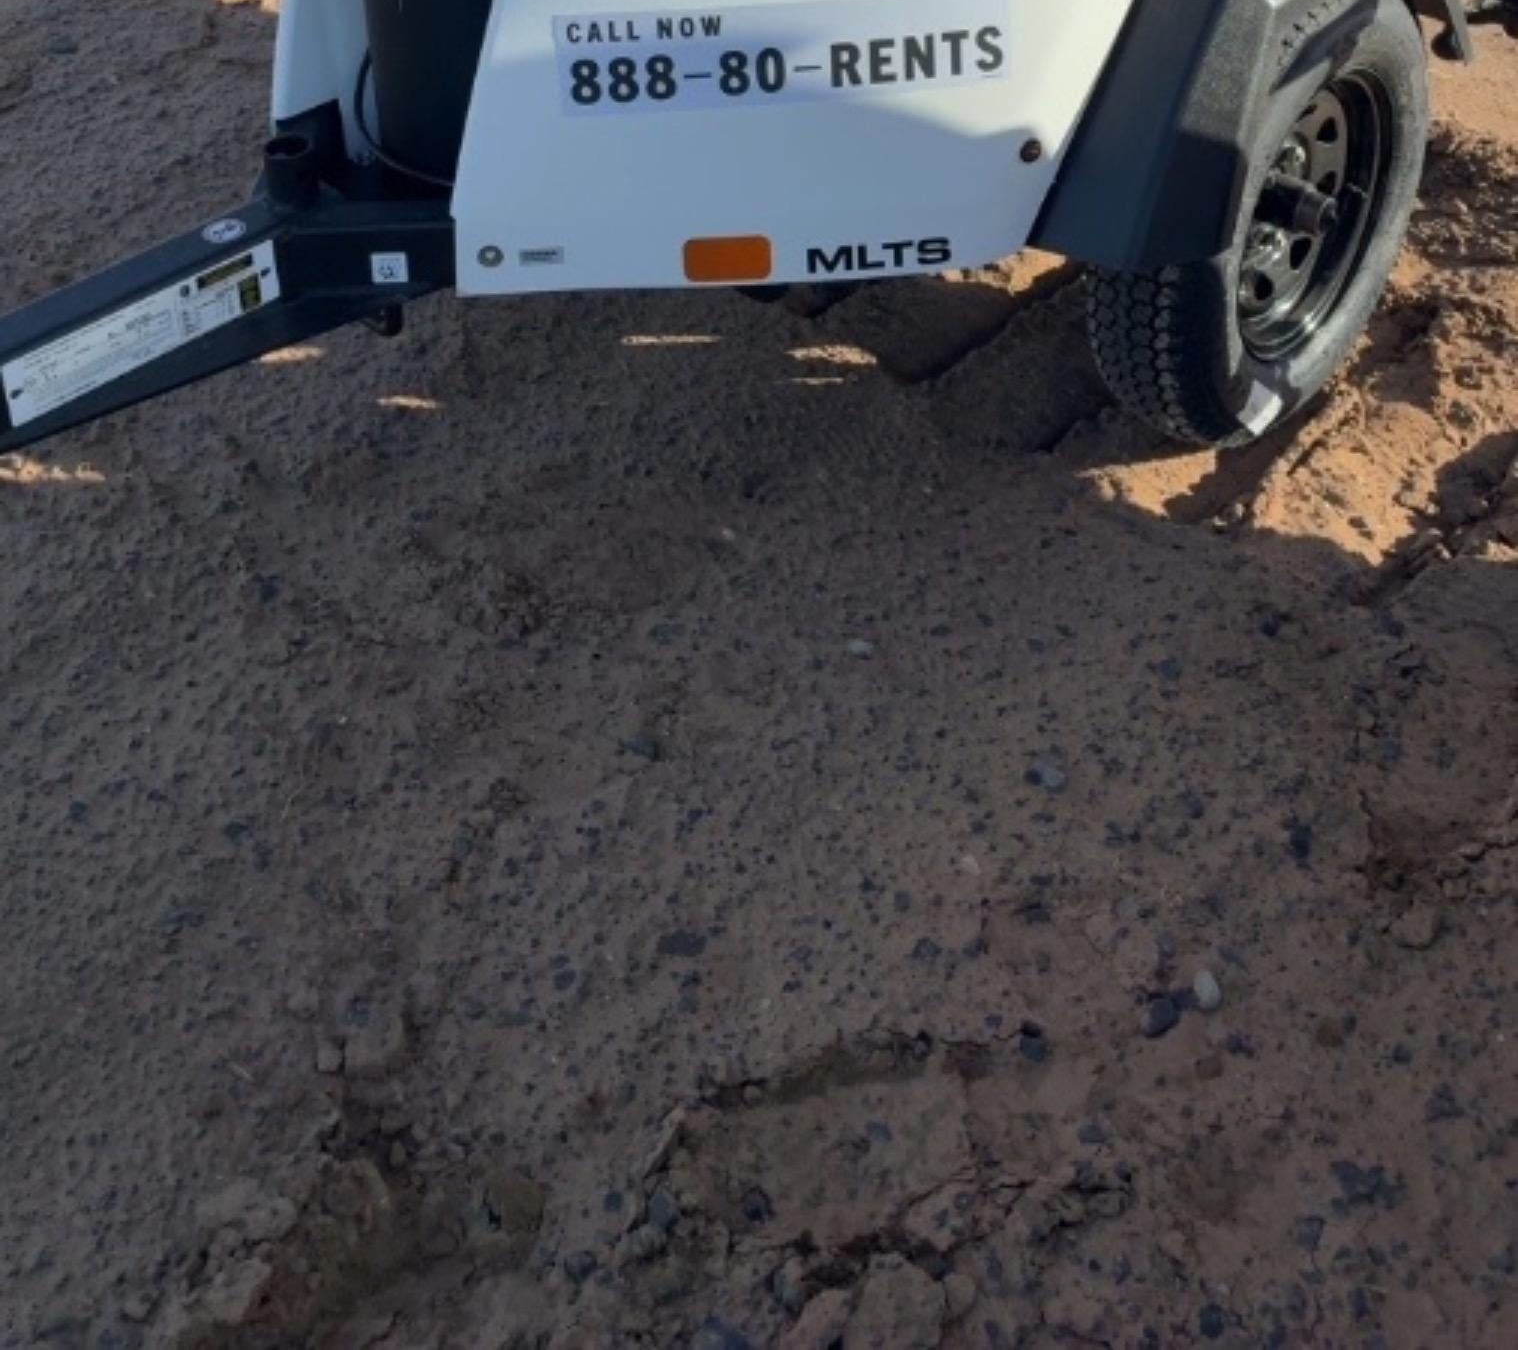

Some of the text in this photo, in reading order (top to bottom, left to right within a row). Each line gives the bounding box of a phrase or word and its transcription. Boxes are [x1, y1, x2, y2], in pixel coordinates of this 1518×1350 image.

[566, 15, 722, 43] CALL NOW
[569, 26, 1004, 105] 888-80-RENTS
[806, 236, 952, 274] MLTS
